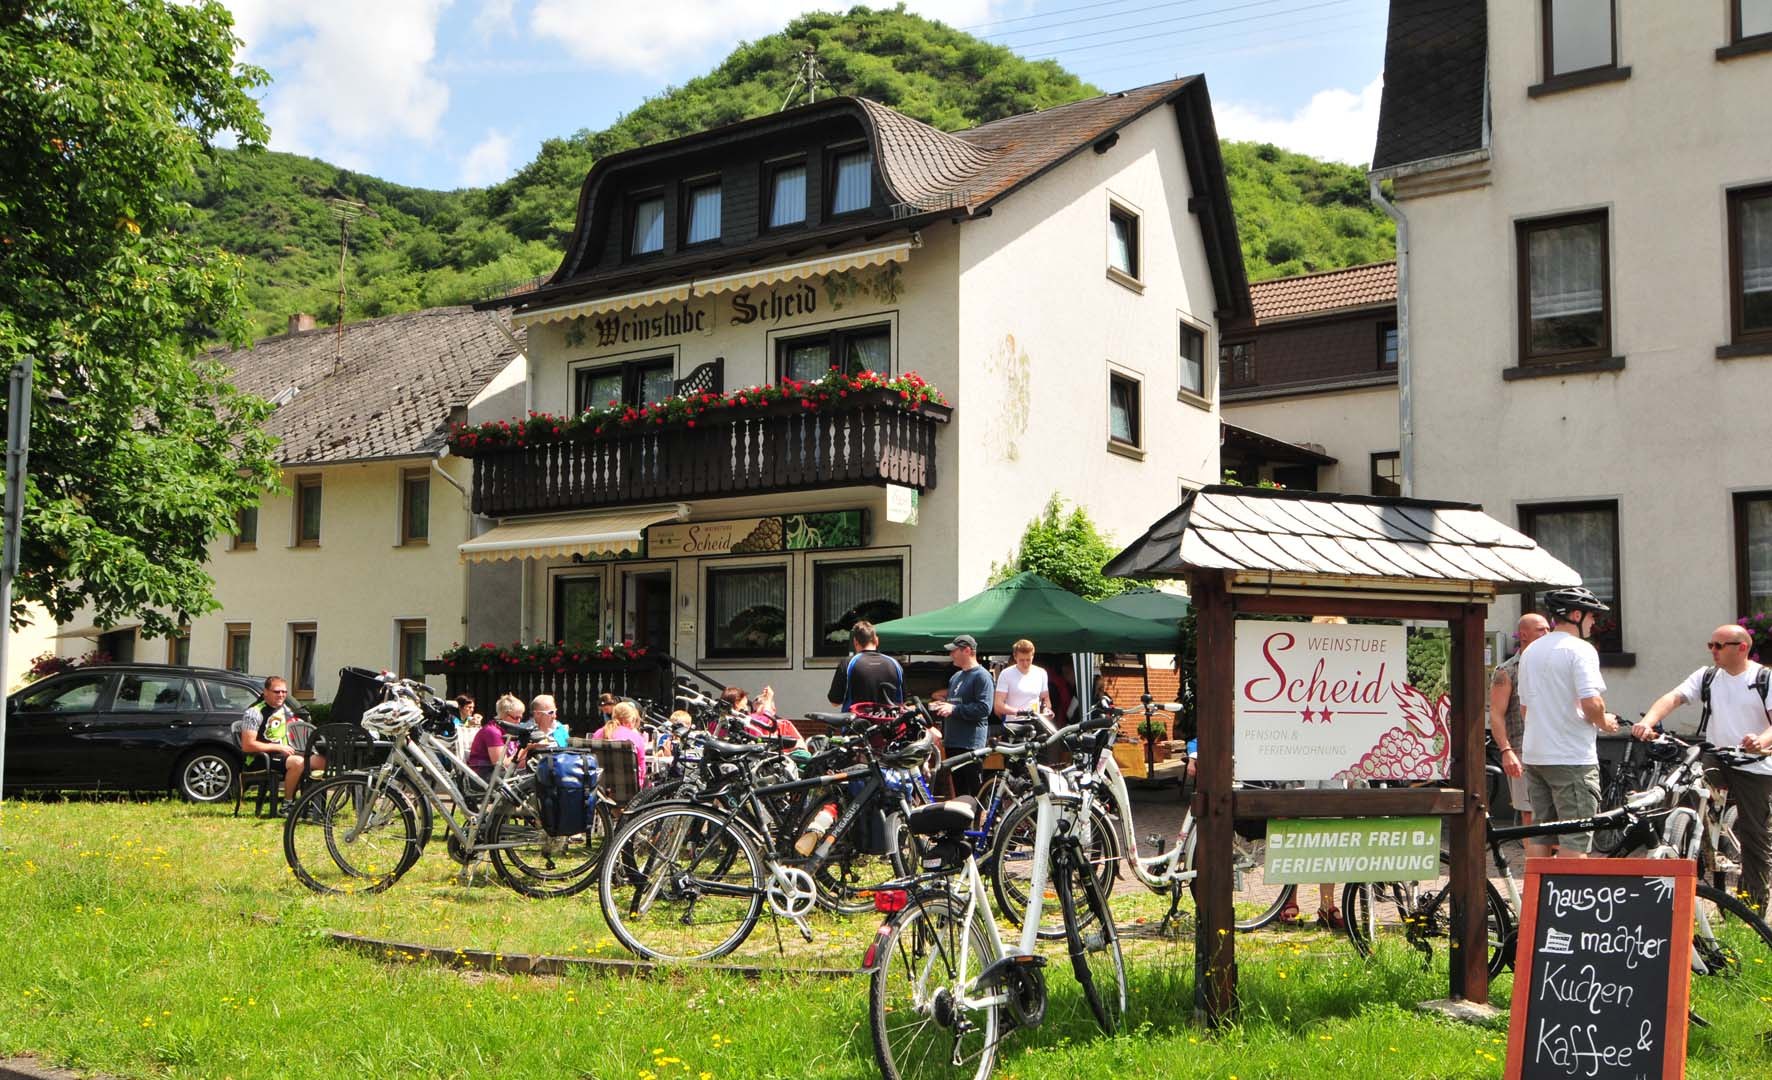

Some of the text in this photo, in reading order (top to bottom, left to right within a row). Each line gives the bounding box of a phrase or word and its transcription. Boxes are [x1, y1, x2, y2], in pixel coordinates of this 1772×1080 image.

[595, 283, 817, 347] Weinstube Scheid
[683, 525, 732, 553] Scheid
[1308, 637, 1387, 652] WEINSTUBE
[1244, 632, 1390, 704] Scheid
[1245, 728, 1287, 741] PENSION
[1258, 745, 1347, 756] FERIENWOHNUNG
[831, 802, 861, 838] PEGASUS
[1284, 832, 1362, 848] ZIMMER
[1368, 831, 1407, 846] FREI
[1271, 855, 1434, 873] FERIENWOHNUNG
[1547, 881, 1640, 923] hausge-
[1581, 925, 1667, 969] machter
[1540, 961, 1634, 1014] Kuchen
[1536, 1018, 1653, 1076] Kaffee &
